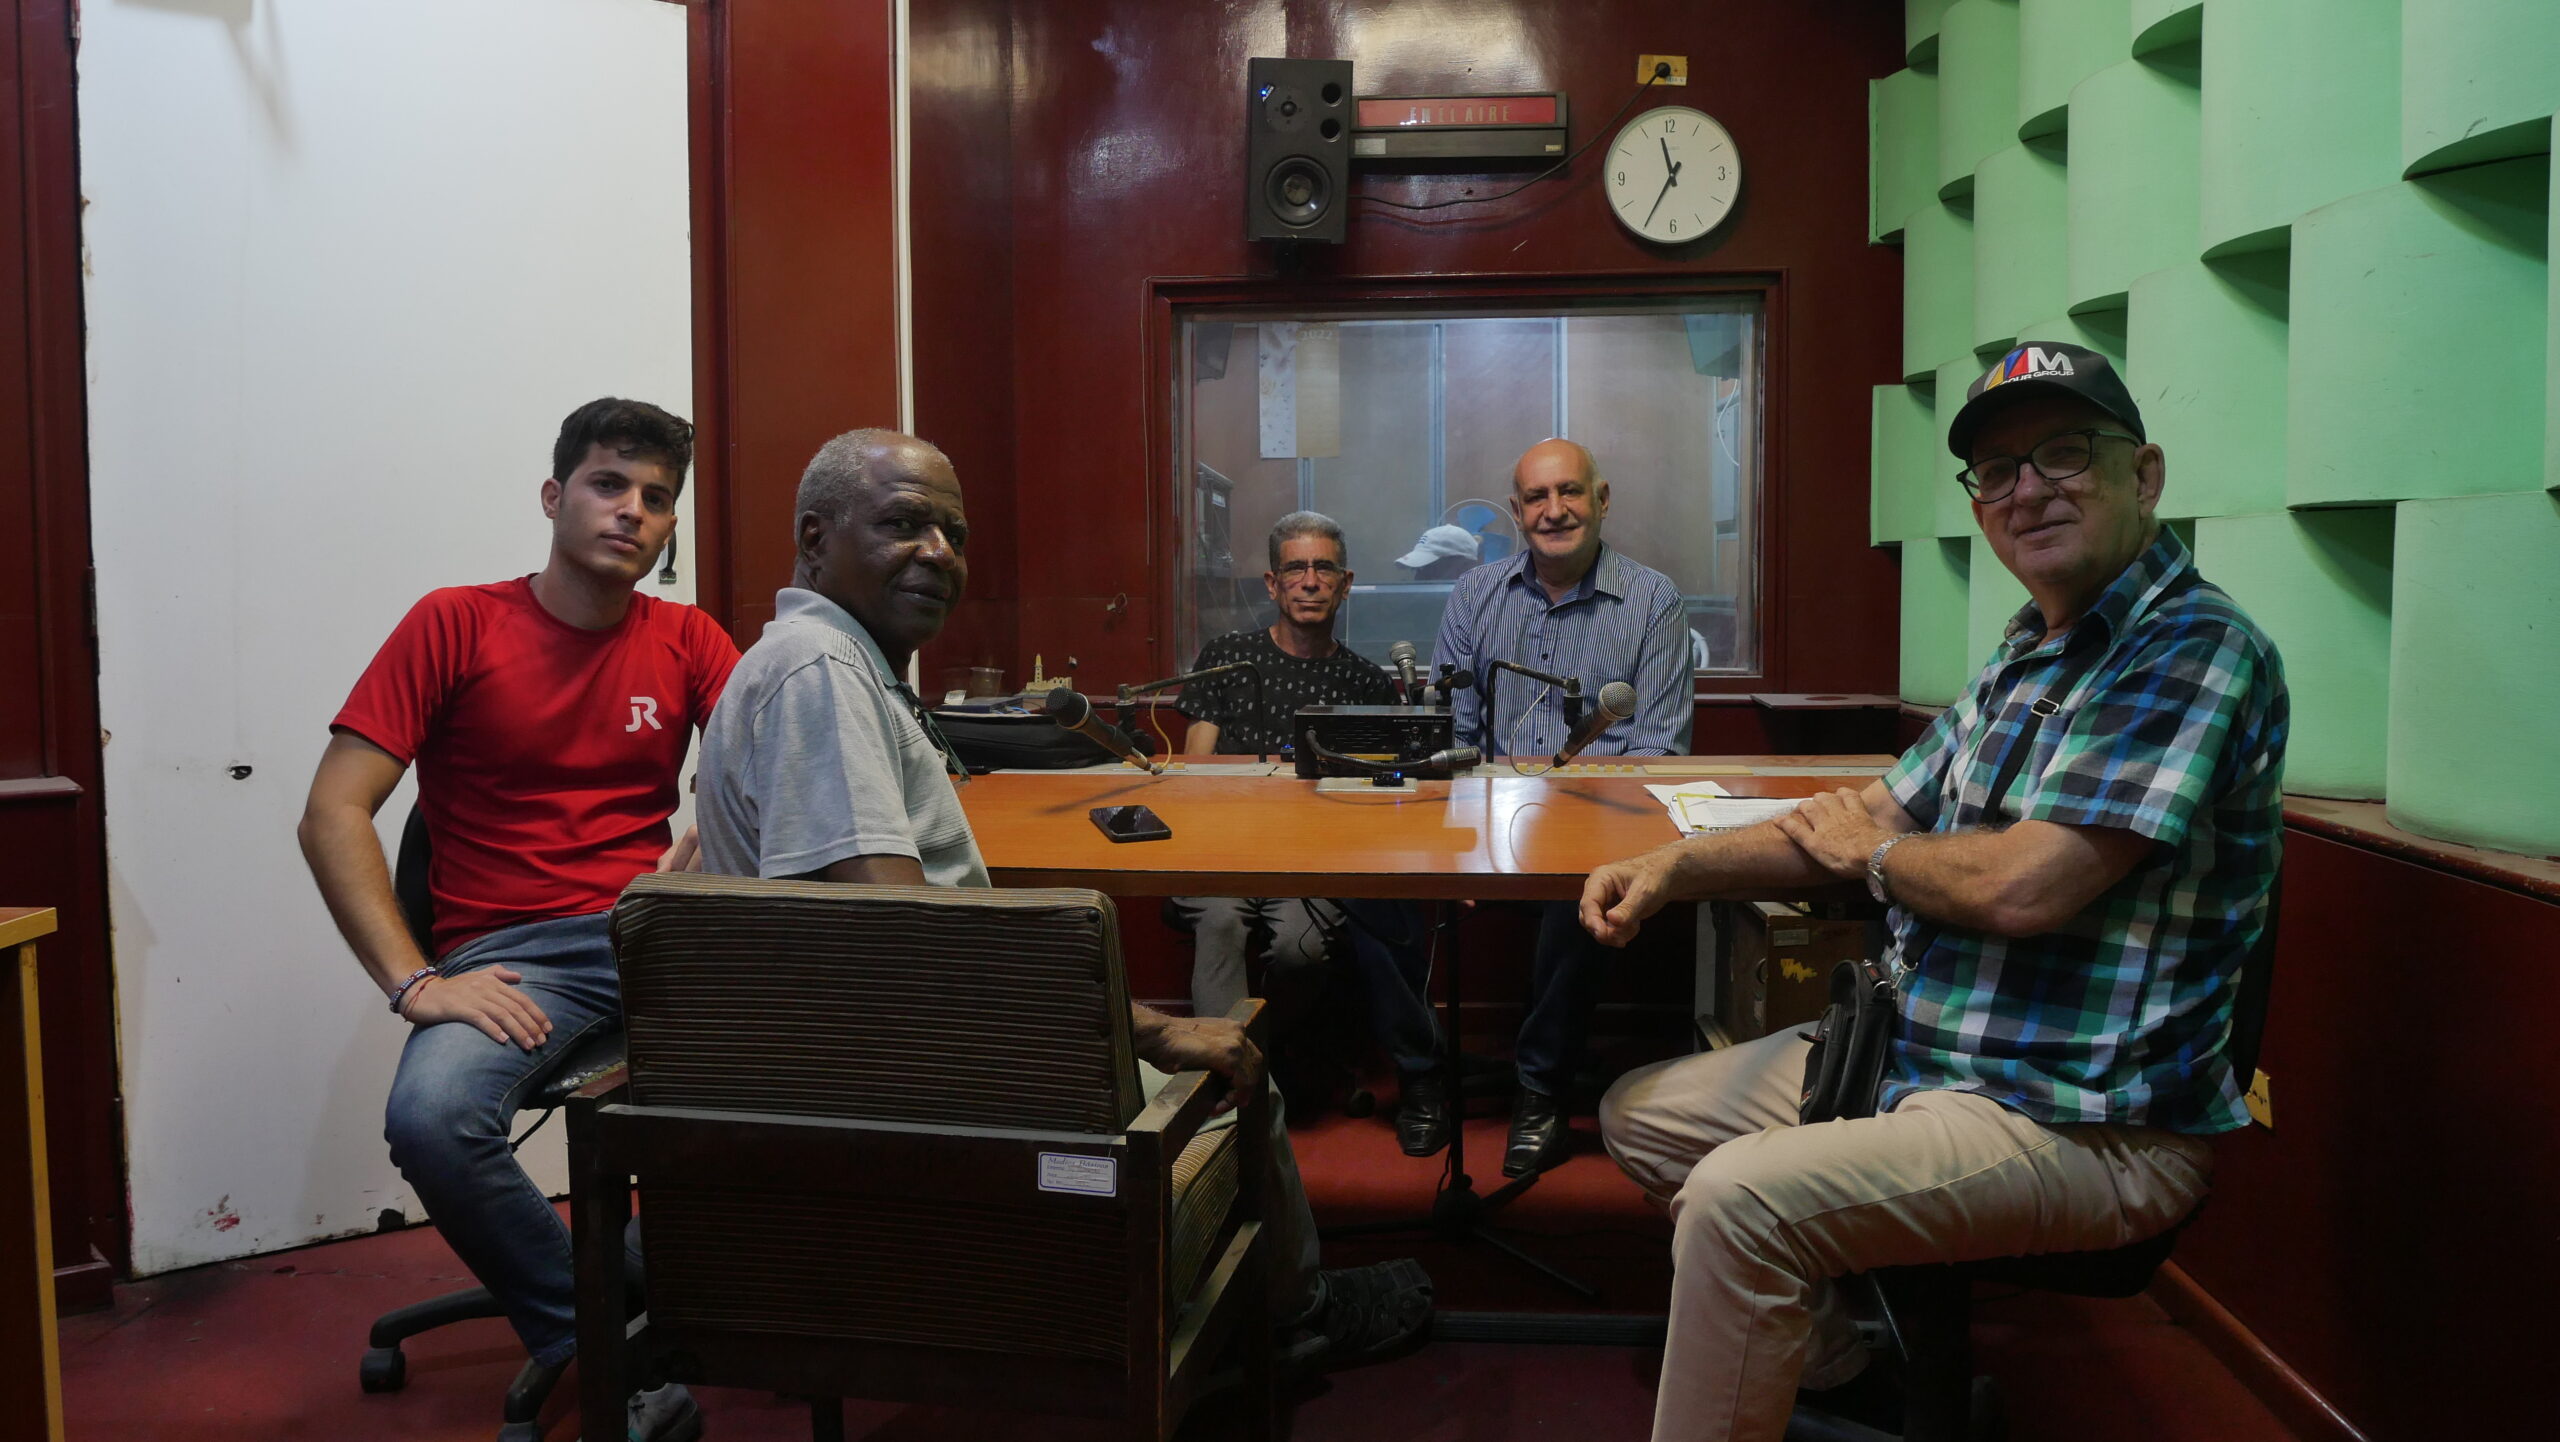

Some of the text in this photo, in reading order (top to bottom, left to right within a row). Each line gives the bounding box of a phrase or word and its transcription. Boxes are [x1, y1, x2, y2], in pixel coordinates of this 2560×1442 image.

[1409, 106, 1431, 122] EN
[1465, 105, 1511, 122] AIRE
[1664, 119, 1676, 134] 12
[1617, 172, 1626, 187] 9
[1717, 166, 1726, 181] 3
[1669, 219, 1677, 234] 6
[2033, 370, 2075, 378] GROUP
[625, 696, 662, 733] JR
